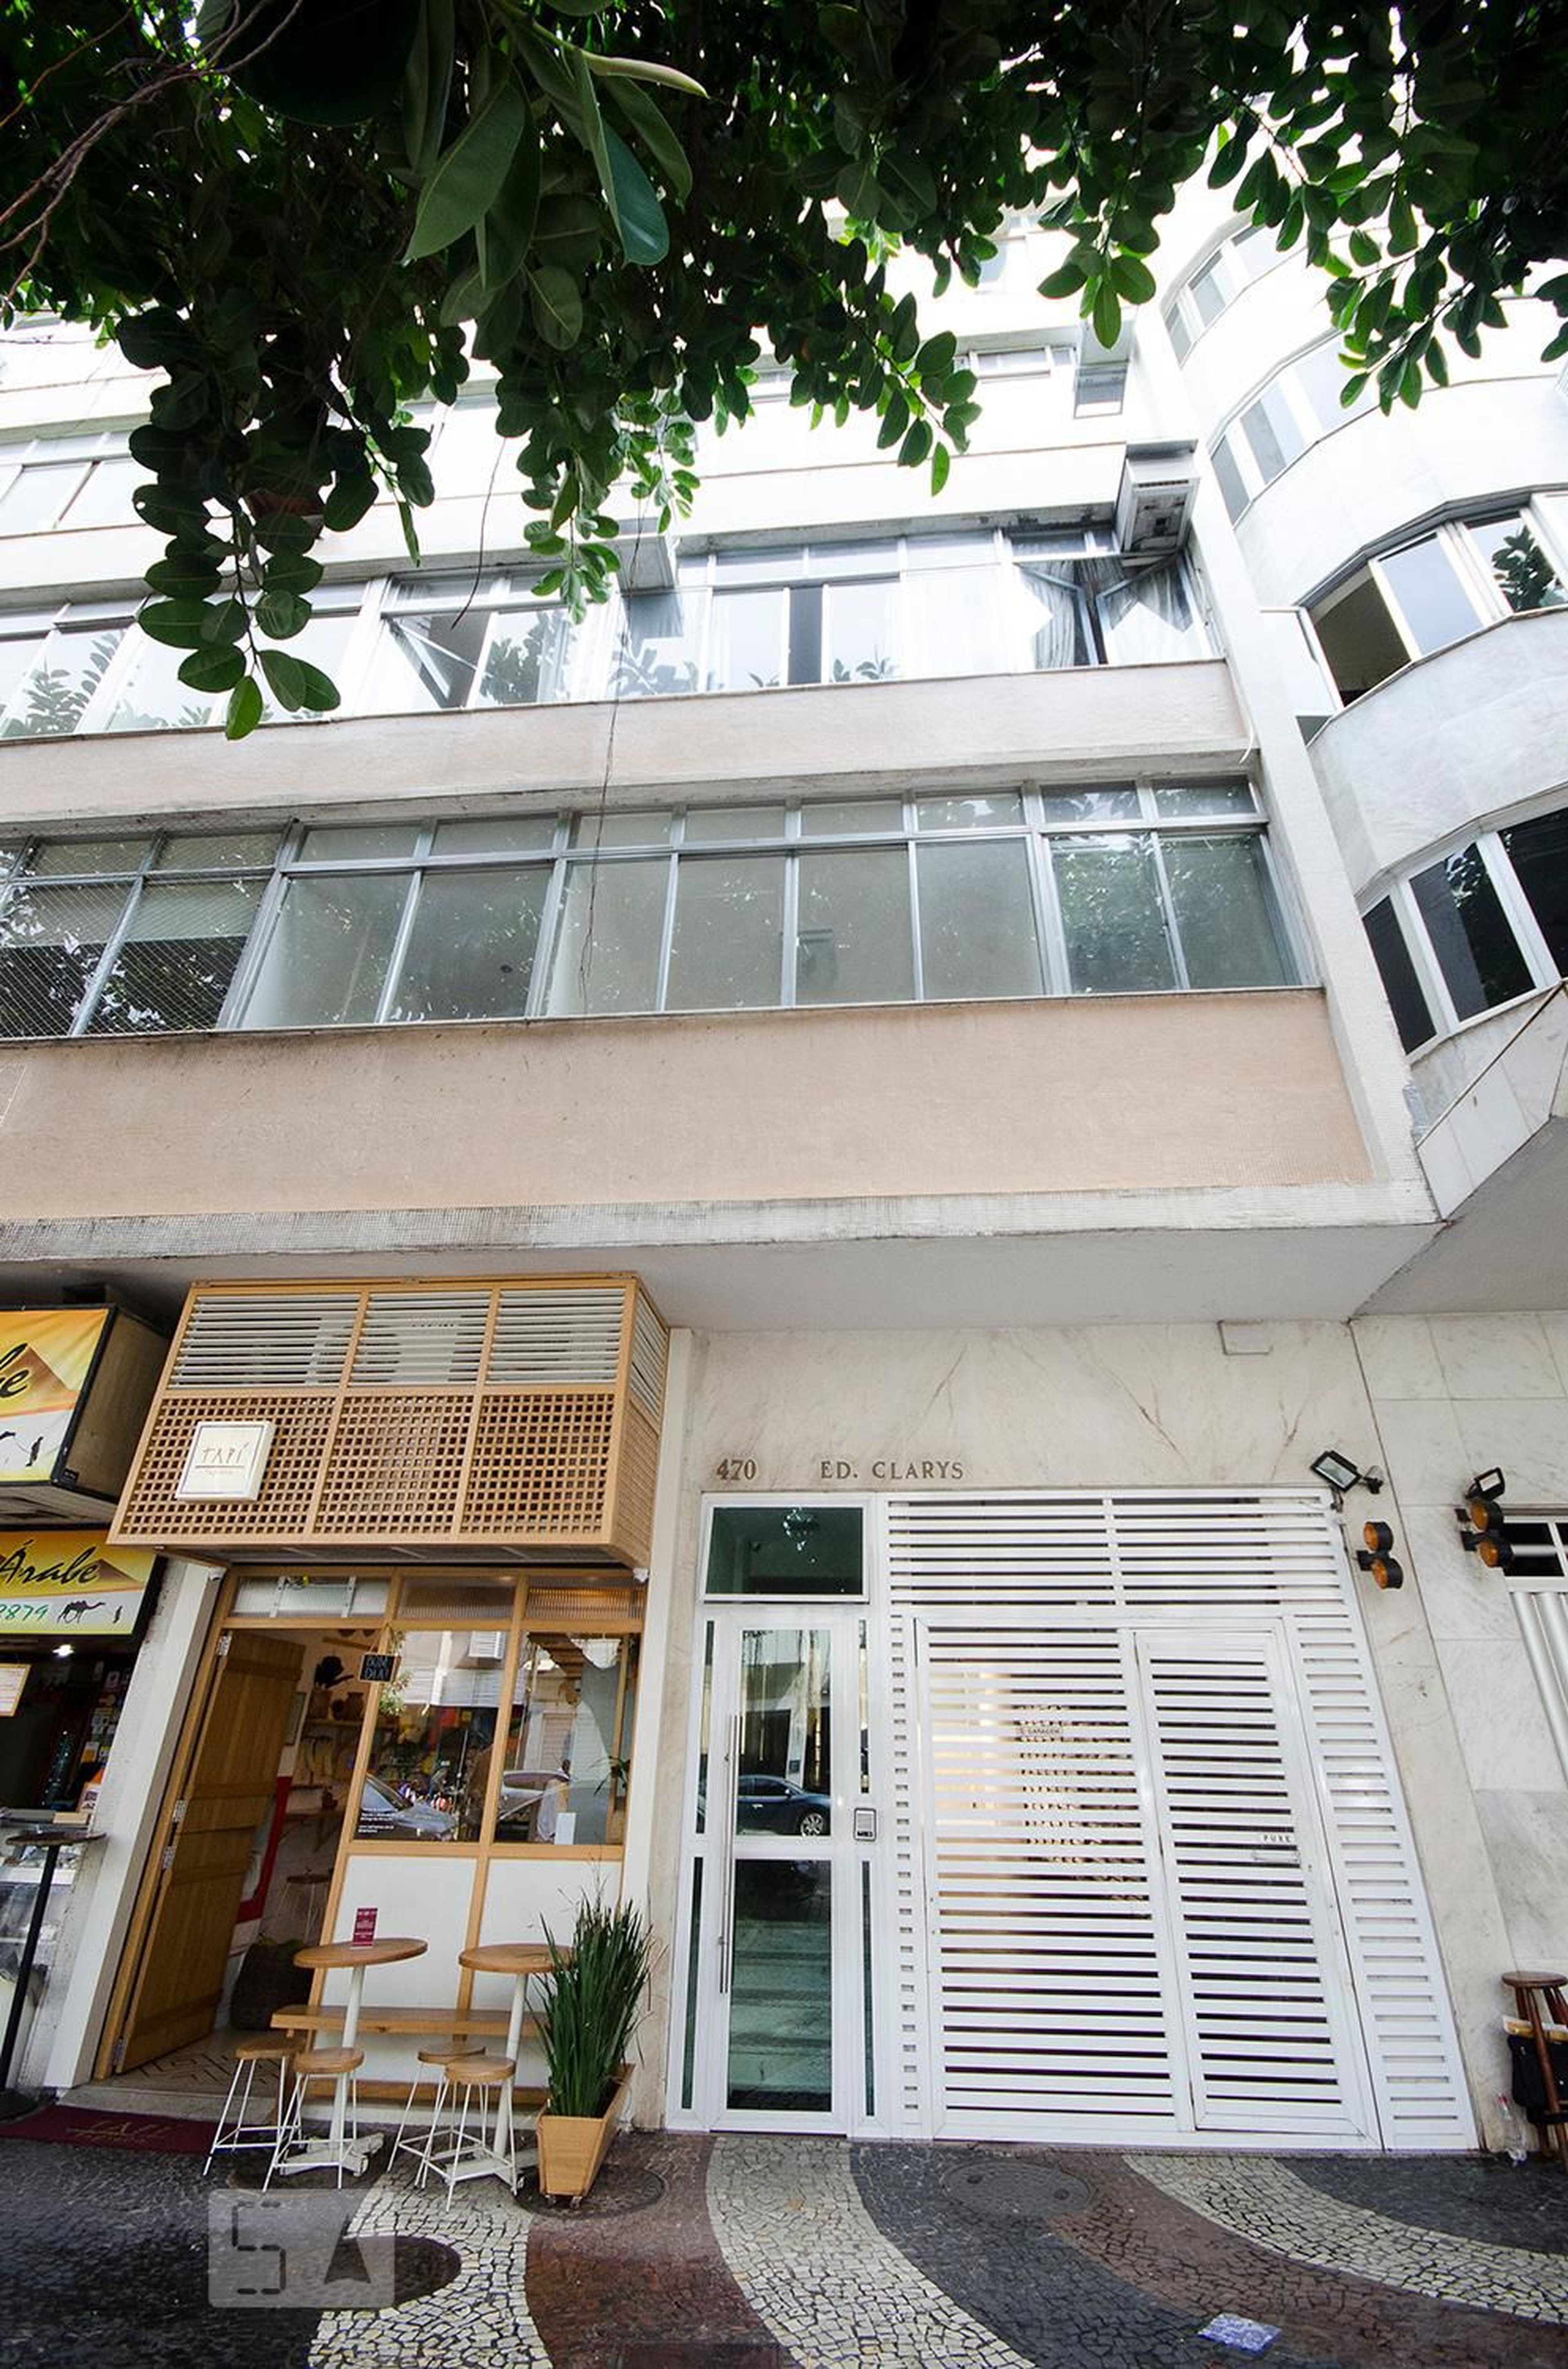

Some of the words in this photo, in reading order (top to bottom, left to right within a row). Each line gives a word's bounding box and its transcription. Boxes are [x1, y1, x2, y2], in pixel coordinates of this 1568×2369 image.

[716, 1458, 756, 1480] 470
[820, 1461, 858, 1480] ED.
[872, 1461, 964, 1480] CLARYS
[0, 1539, 98, 1585] Árabe
